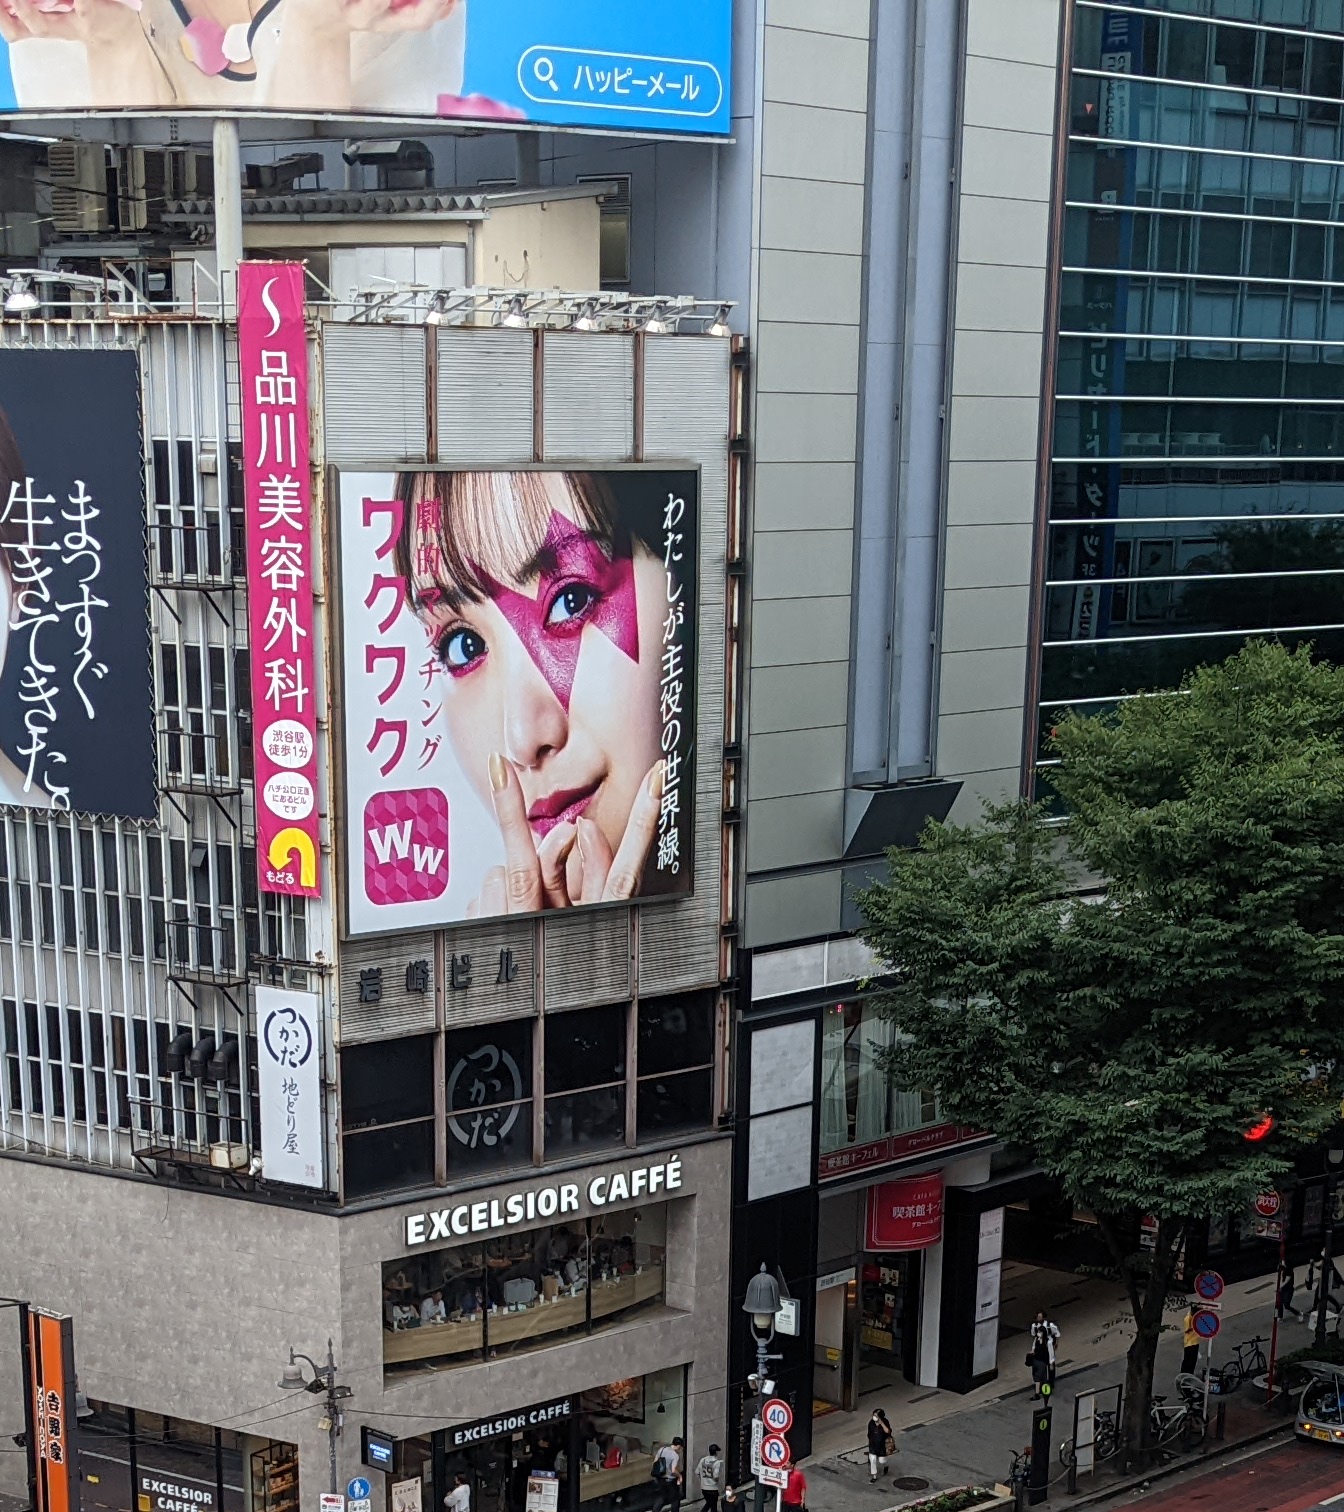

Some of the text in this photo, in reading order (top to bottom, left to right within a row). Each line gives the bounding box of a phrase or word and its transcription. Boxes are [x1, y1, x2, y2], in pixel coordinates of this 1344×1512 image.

[573, 64, 700, 101] ハッピーメール
[255, 348, 309, 712] 品川美容外科
[0, 476, 72, 812] 生きてきた。
[361, 496, 408, 779] ワクワク
[656, 490, 686, 876] わたしが主役の世界線。
[268, 744, 308, 759] 徒歩1分
[272, 729, 306, 745] 渋谷駅
[282, 805, 298, 814] です
[266, 870, 295, 885] もどる
[358, 947, 519, 1003] 岩崎ビル
[276, 1007, 300, 1069] つかだ
[282, 1076, 300, 1156] 地どり屋
[465, 1043, 503, 1149] つかだ
[406, 1153, 684, 1247] EXCELSIOR CAFFÉ
[46, 1389, 64, 1465] 吉野家
[454, 1399, 572, 1446] EXCELSIOR CAFFÉ
[768, 1408, 786, 1425] 40
[141, 1476, 213, 1507] EXCELSIOR
